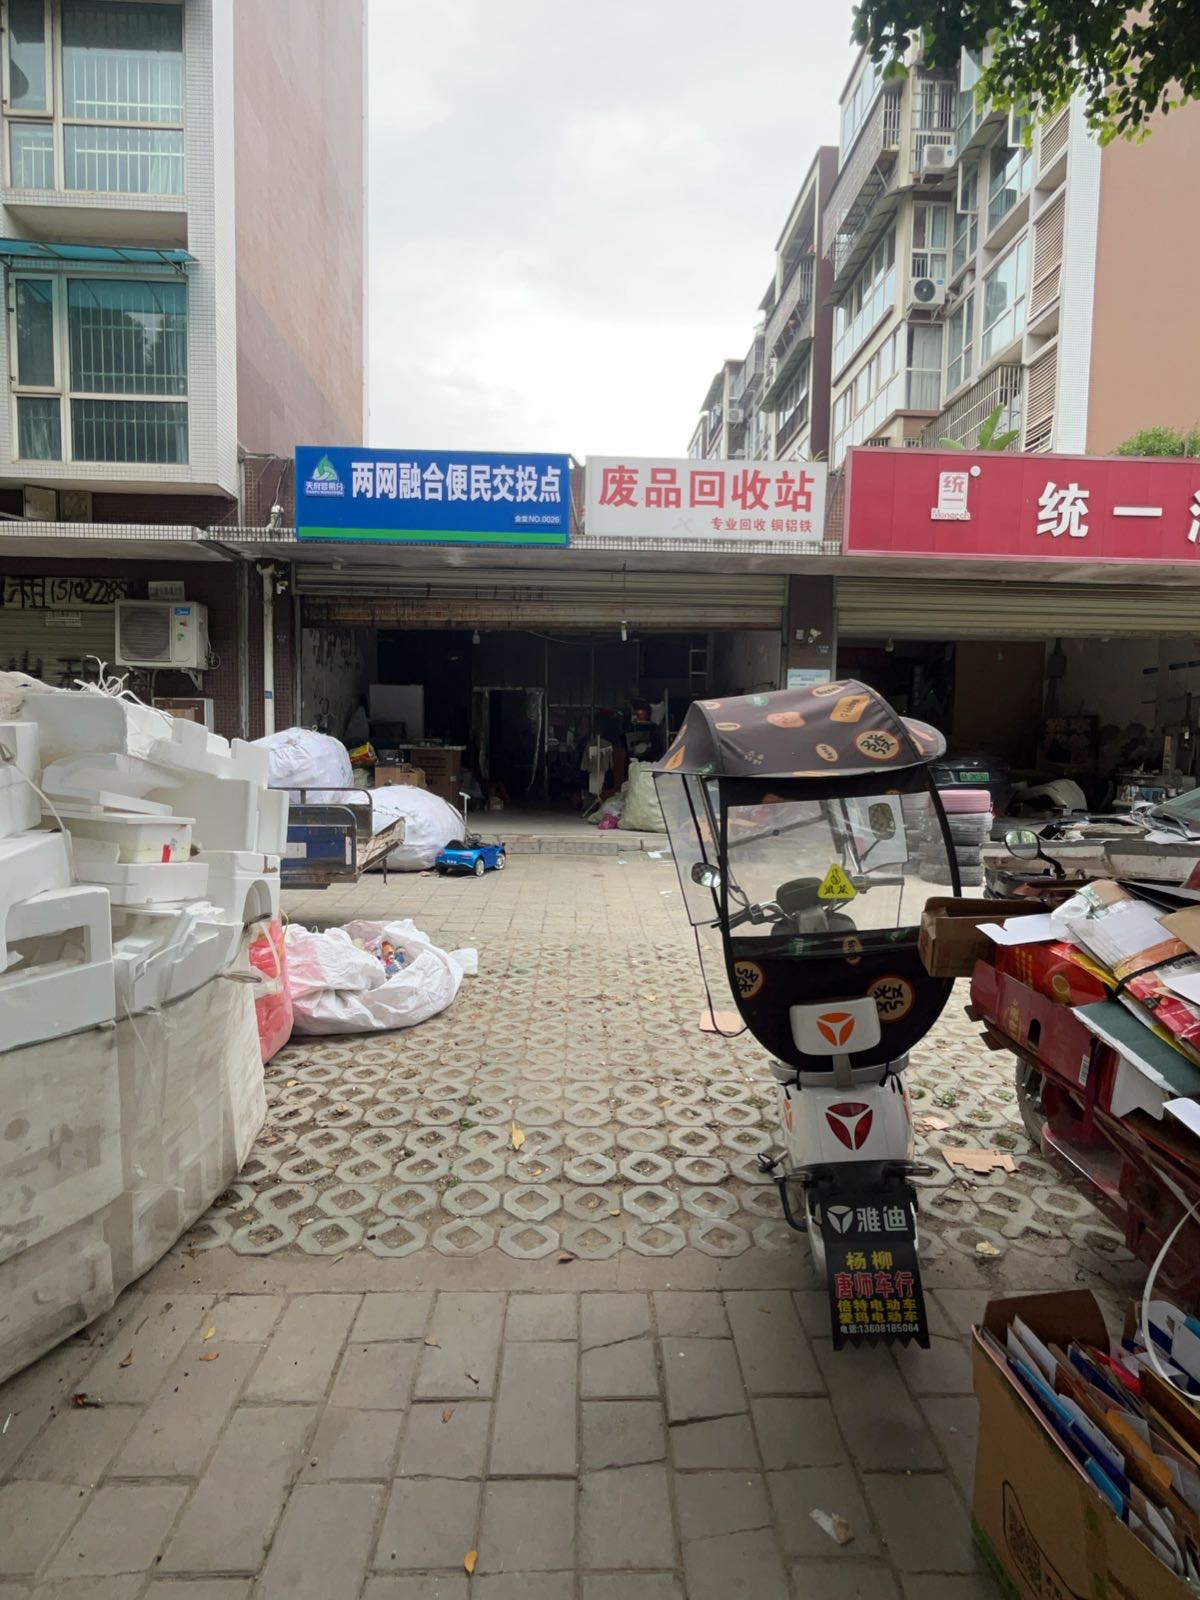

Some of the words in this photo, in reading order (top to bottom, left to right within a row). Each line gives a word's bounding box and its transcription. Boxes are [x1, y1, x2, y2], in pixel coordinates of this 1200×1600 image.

[351, 462, 562, 503] 两网融合便民交投点
[598, 465, 815, 513] 废品回收站
[1036, 481, 1200, 544] 统一
[856, 1205, 909, 1233] 雅迪
[833, 1270, 914, 1299] 唐师车行
